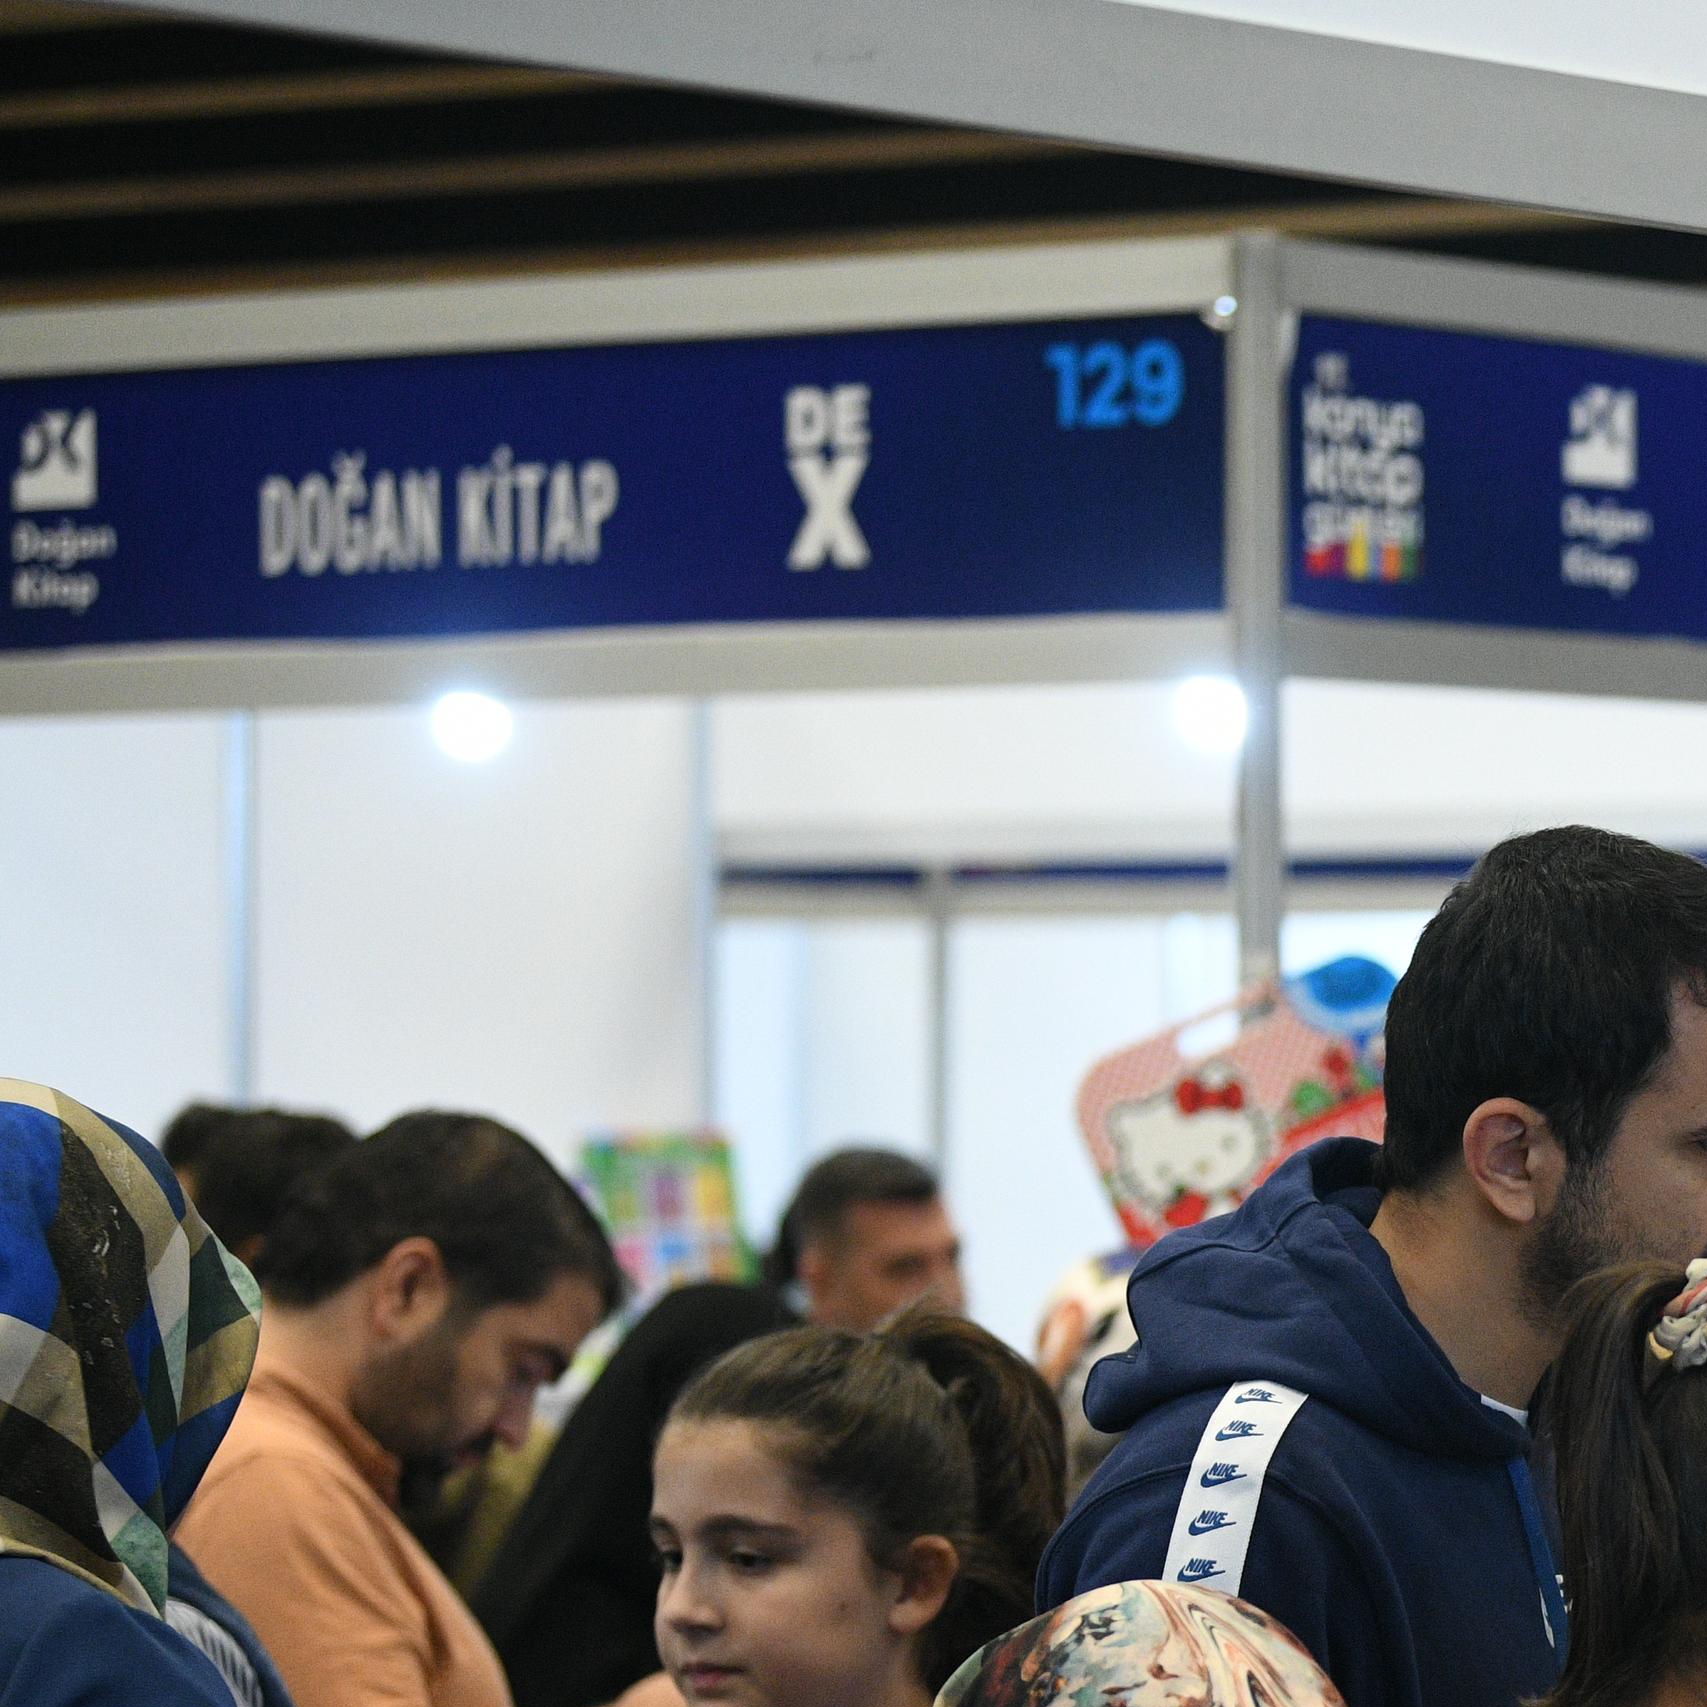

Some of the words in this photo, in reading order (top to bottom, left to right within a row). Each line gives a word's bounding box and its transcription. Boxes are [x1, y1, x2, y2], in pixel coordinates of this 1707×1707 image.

[1045, 339, 1185, 429] 129
[259, 448, 442, 578] DOĞAN
[456, 442, 620, 568] KİTAP
[1247, 1387, 1276, 1399] NIKE
[1228, 1419, 1257, 1432] NIKE
[1208, 1462, 1239, 1476] NIKE
[1196, 1510, 1228, 1525] NIKE
[1185, 1557, 1217, 1573] NIKE
